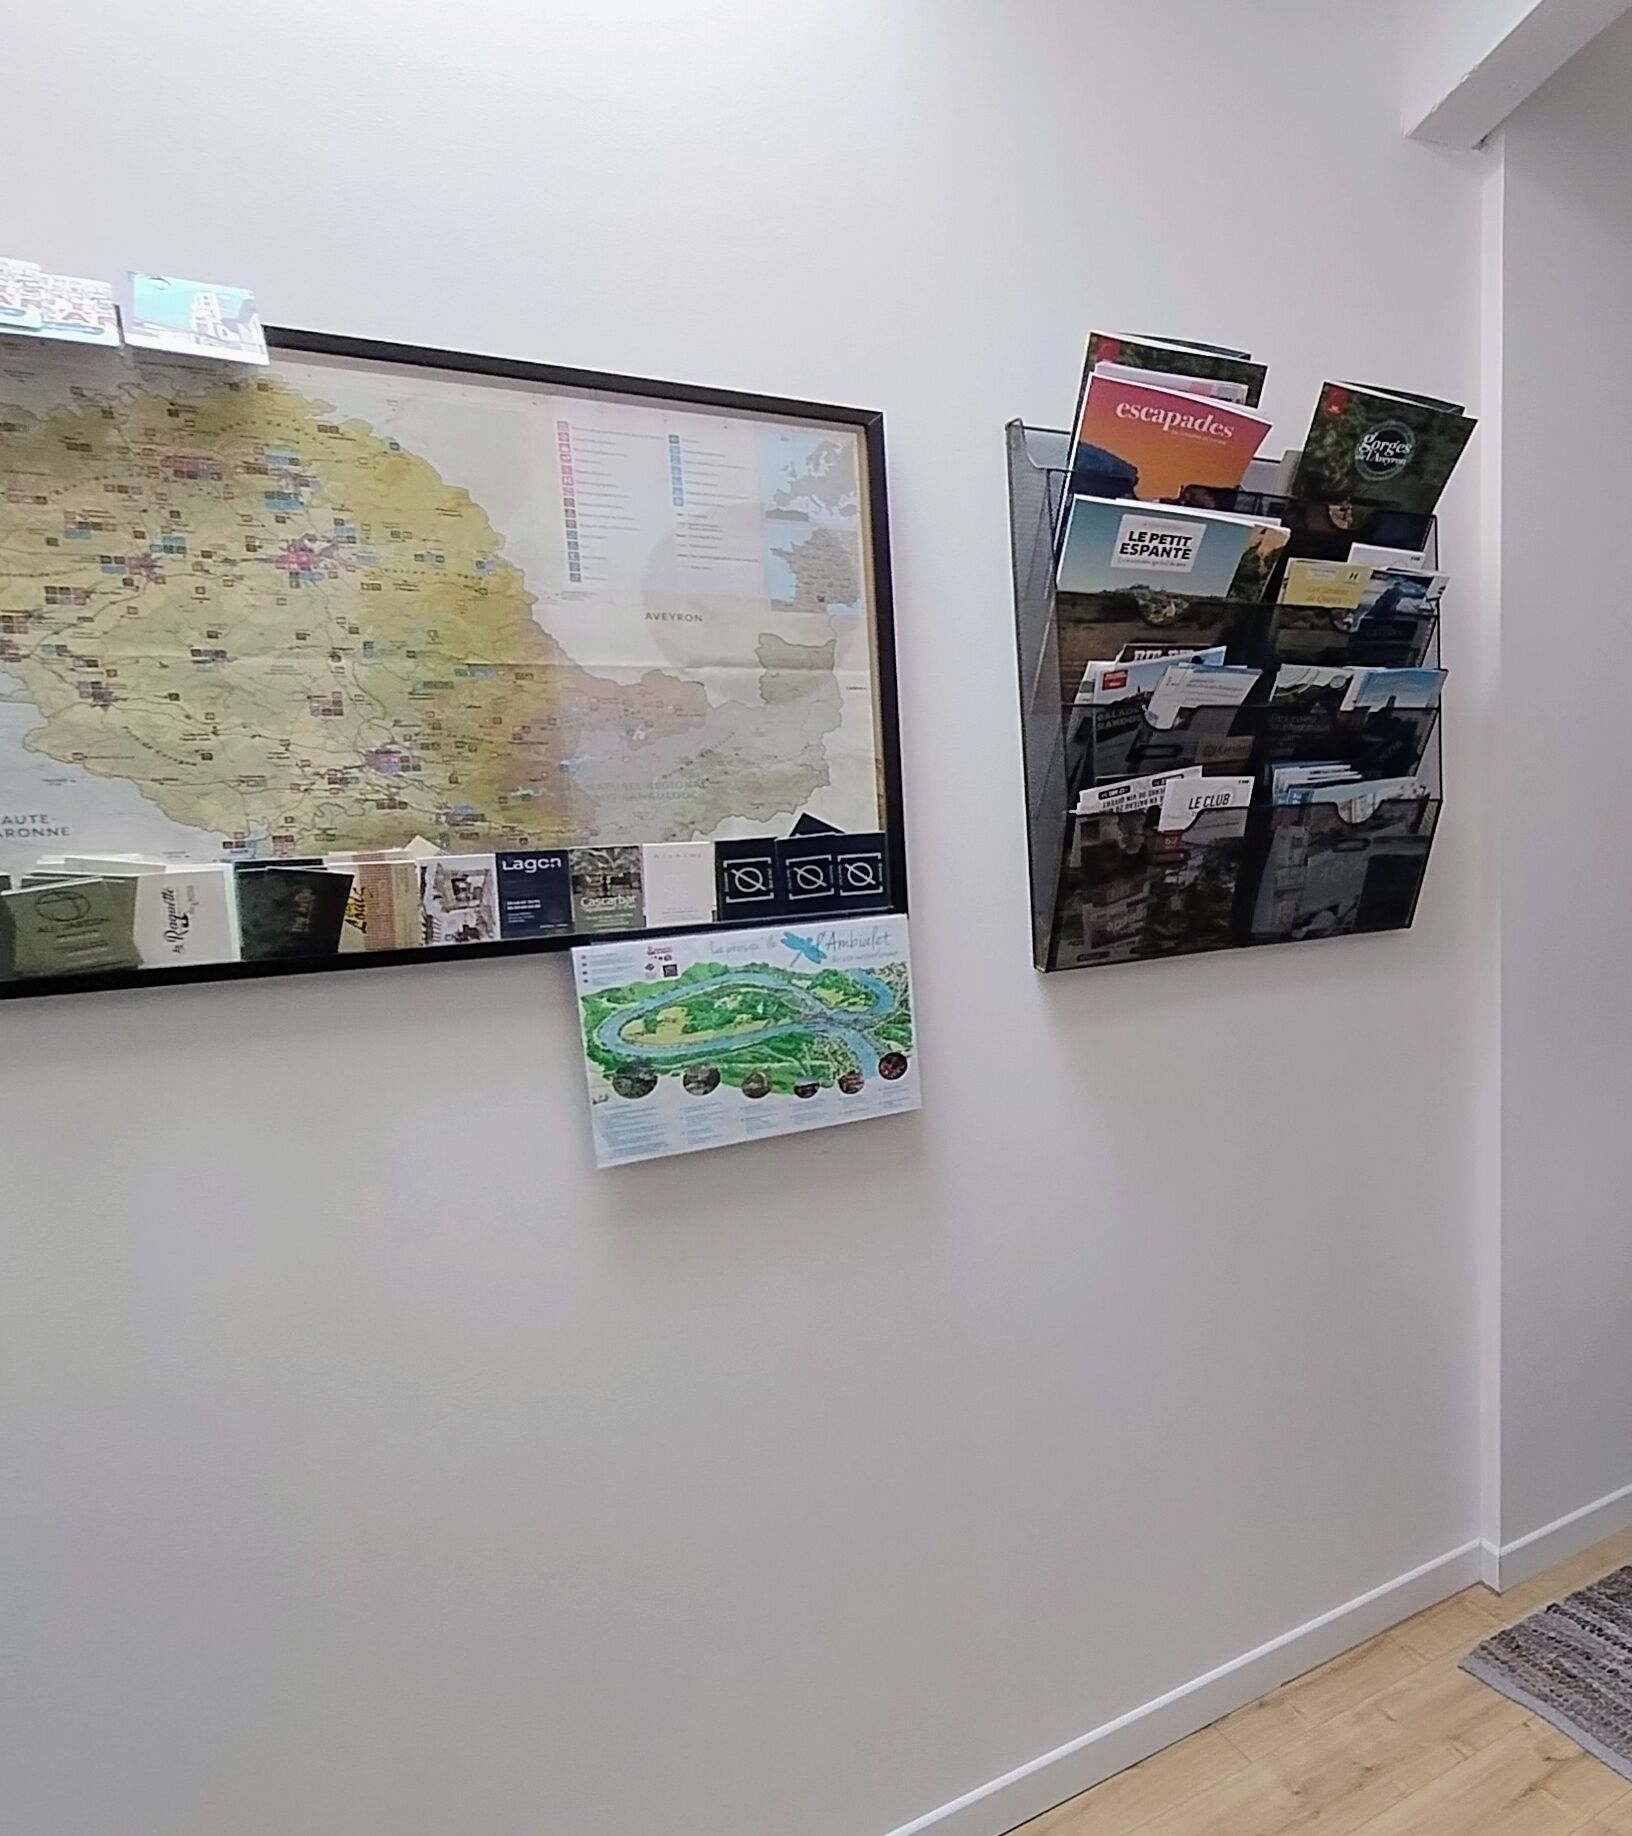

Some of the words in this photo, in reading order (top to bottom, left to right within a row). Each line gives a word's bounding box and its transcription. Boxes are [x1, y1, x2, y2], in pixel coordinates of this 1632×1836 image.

[1115, 402, 1235, 438] escapades
[1359, 432, 1412, 457] gorges
[1128, 531, 1147, 542] LE
[1149, 533, 1192, 547] PETIT
[645, 612, 704, 622] AVEYRON
[1188, 796, 1202, 810] LE
[1203, 793, 1231, 806] CLUB
[0, 814, 57, 825] AUTE-
